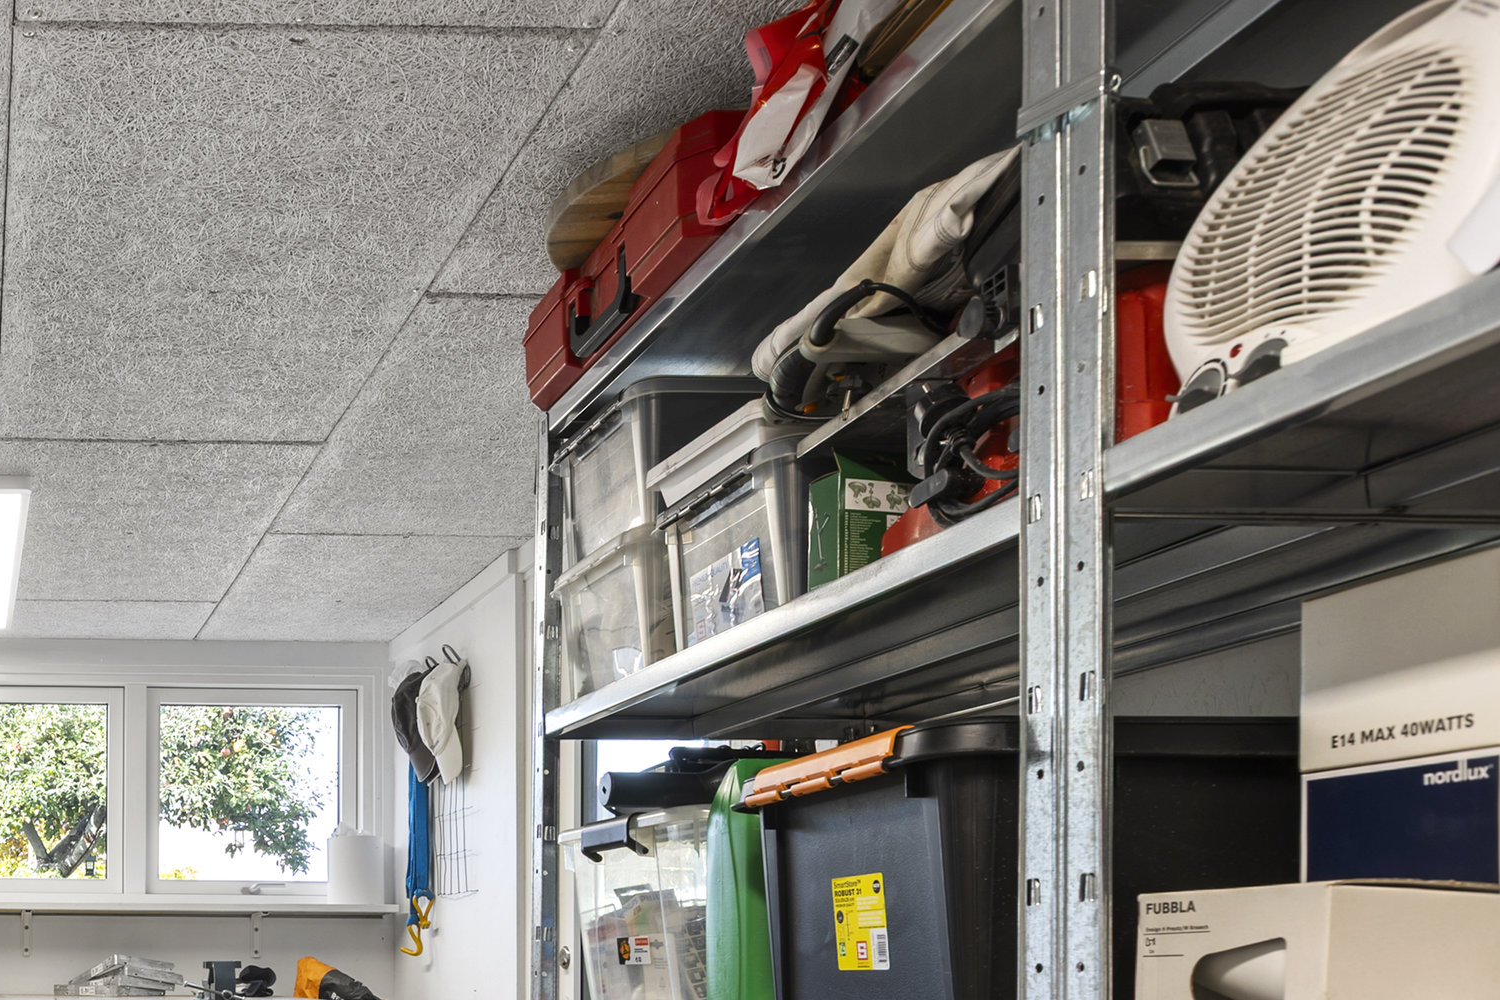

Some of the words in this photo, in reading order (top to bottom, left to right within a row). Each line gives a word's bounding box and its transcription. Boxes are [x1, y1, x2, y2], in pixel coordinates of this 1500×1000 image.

[1331, 732, 1355, 749] E14
[1360, 725, 1396, 744] MAX
[1400, 713, 1475, 737] 40WATTS
[1422, 759, 1490, 786] nordlux
[834, 888, 855, 897] ROBUST
[1145, 900, 1196, 915] FUBBLA
